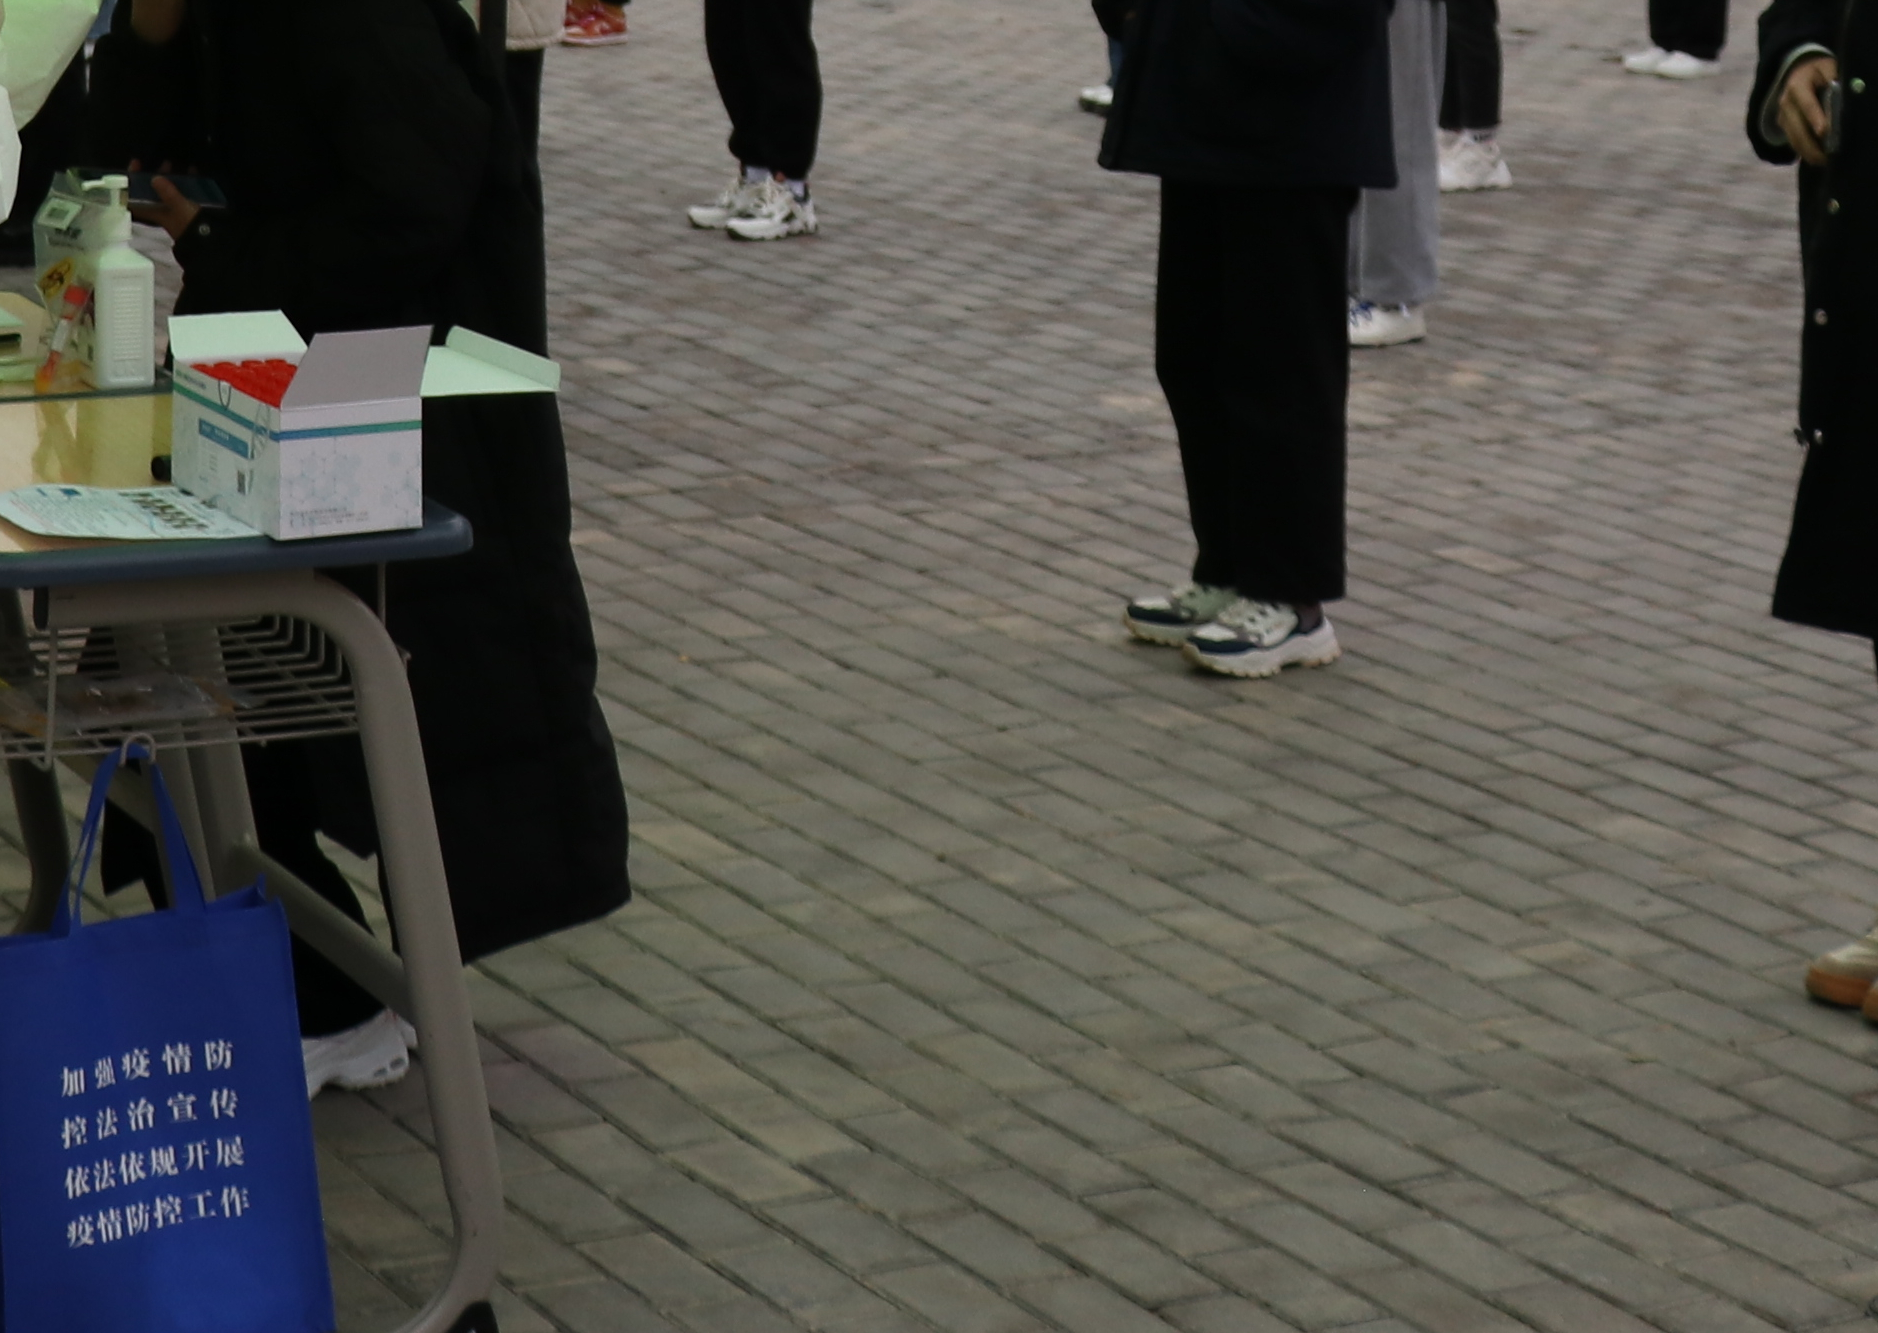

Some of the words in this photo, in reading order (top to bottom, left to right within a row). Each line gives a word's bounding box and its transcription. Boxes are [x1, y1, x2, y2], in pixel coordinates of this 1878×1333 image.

[61, 1039, 234, 1097] 加强疫情防
[61, 1085, 239, 1150] 控法治宣传
[64, 1134, 245, 1200] 依法依规开展
[67, 1185, 250, 1248] 疫情防控工作
